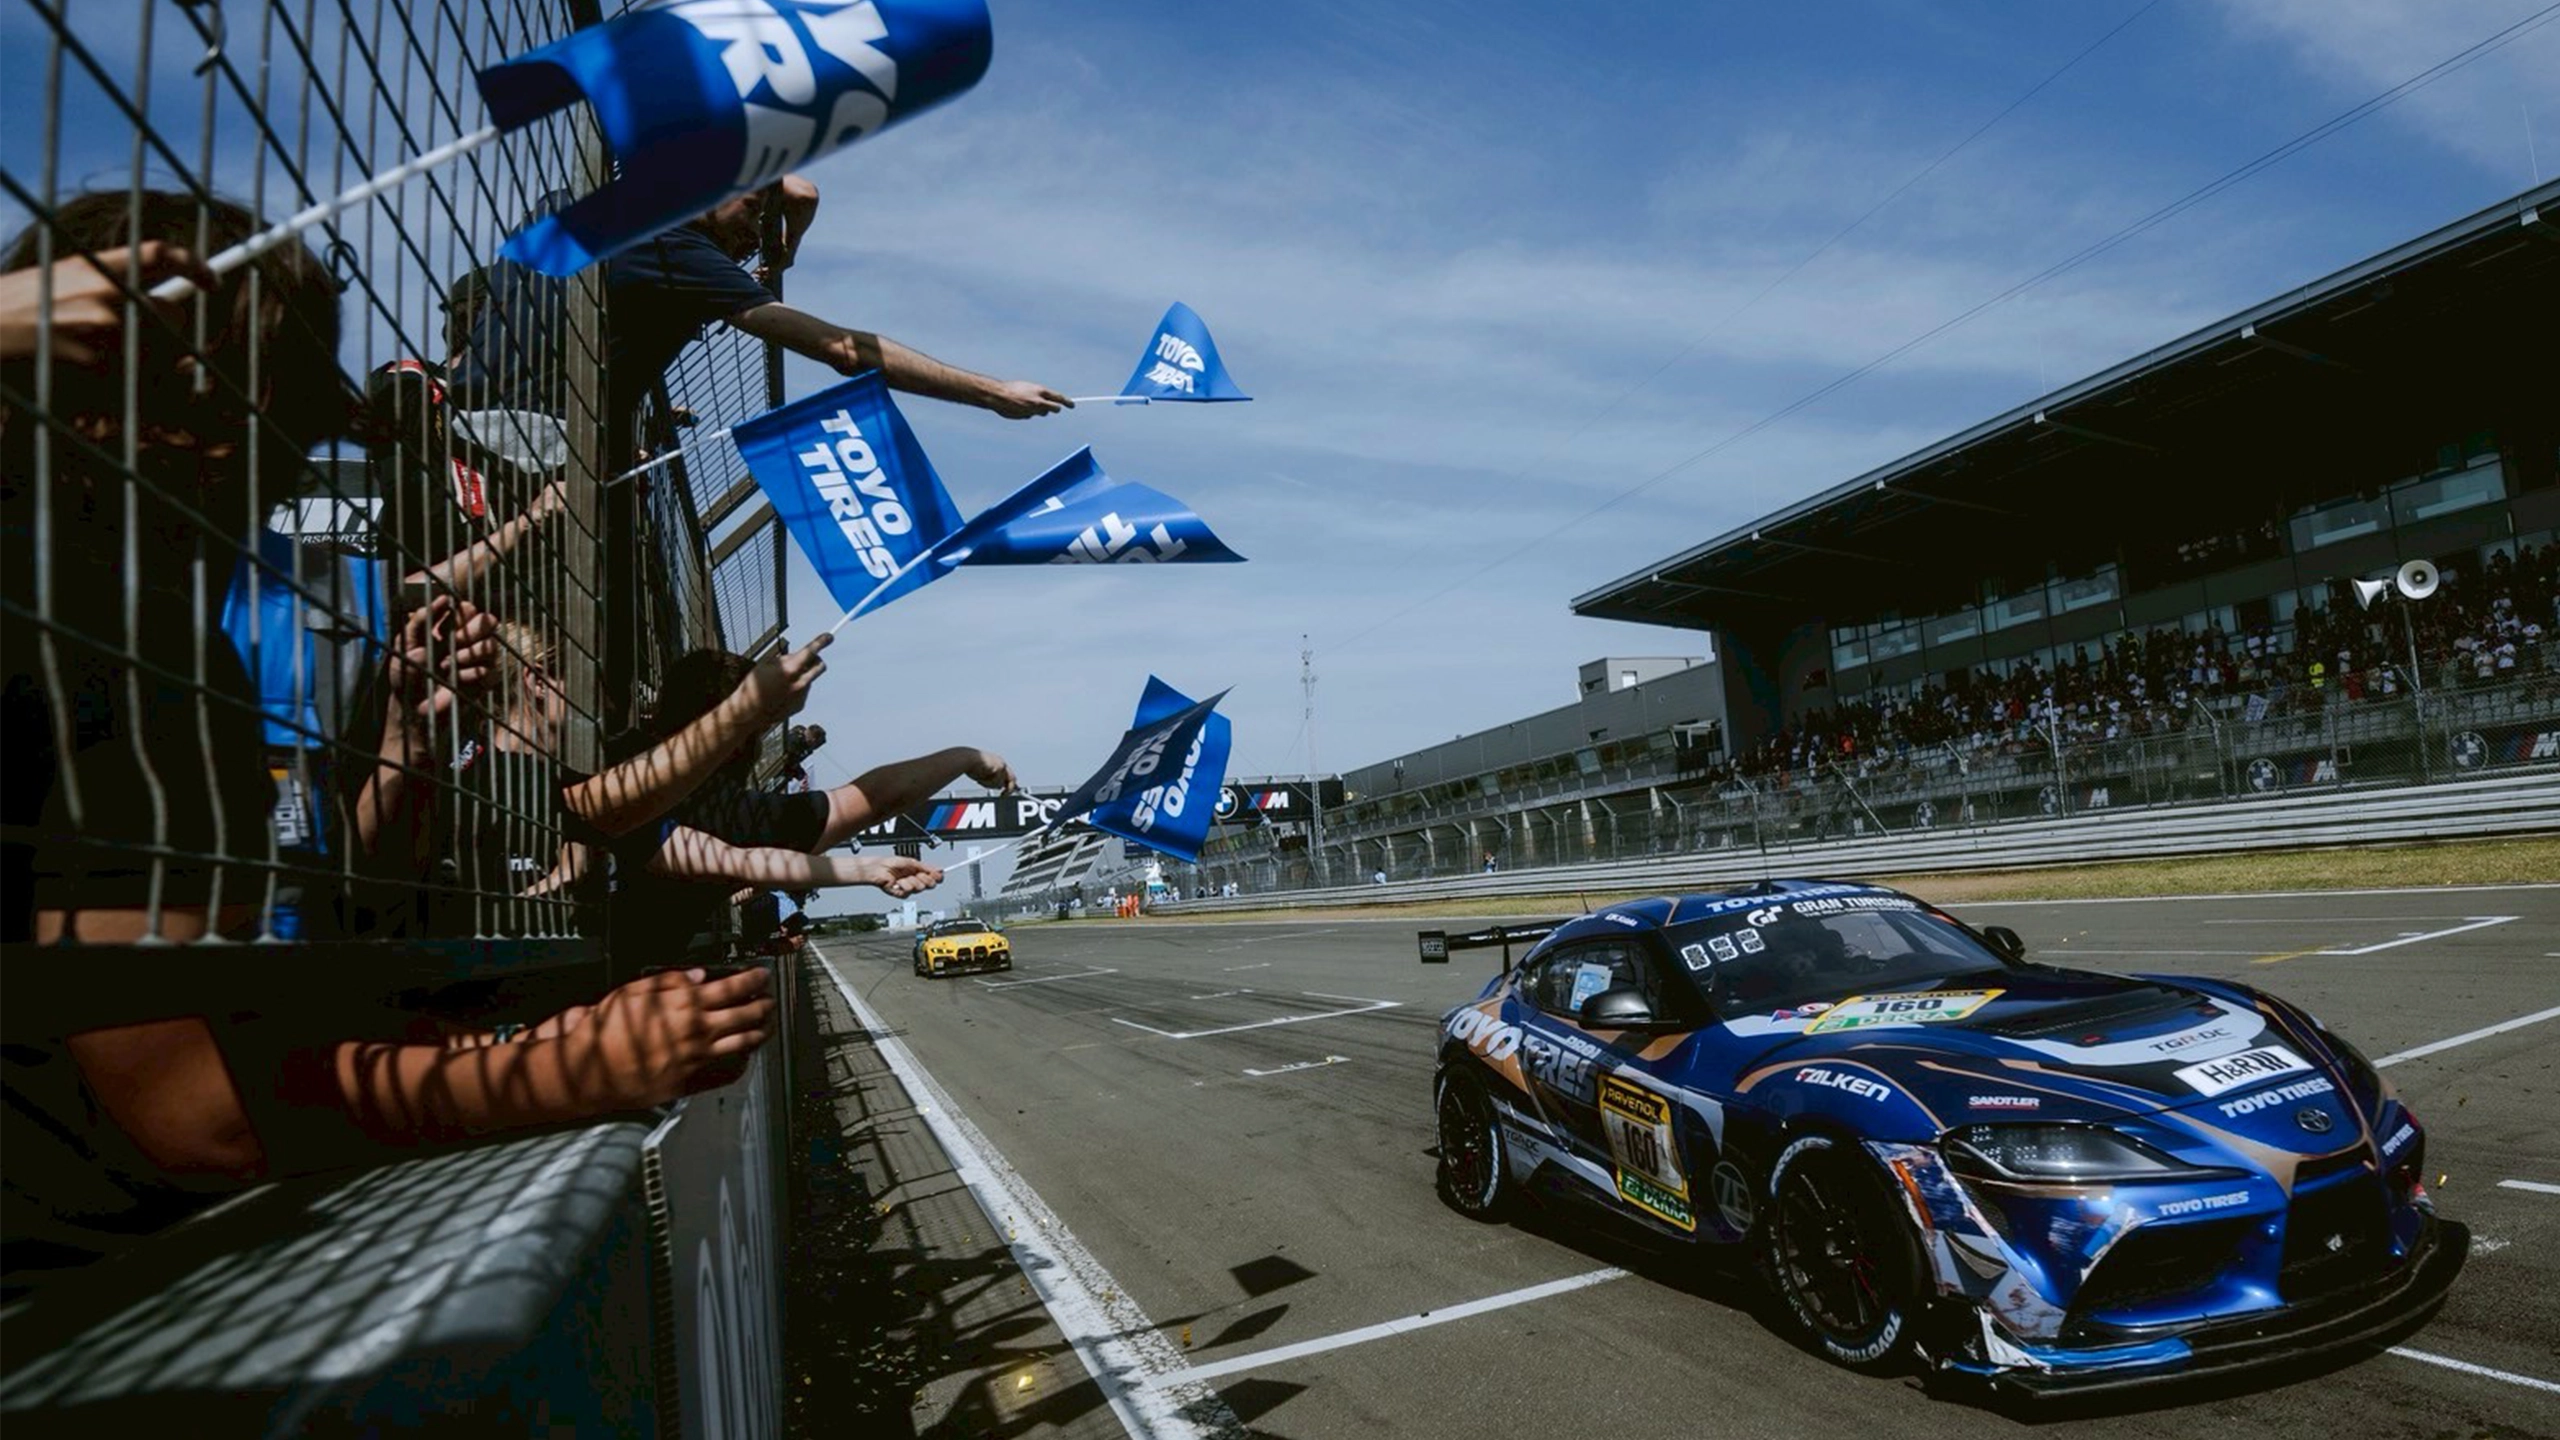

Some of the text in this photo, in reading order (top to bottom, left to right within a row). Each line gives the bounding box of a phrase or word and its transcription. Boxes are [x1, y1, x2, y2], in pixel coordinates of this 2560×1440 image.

[1154, 332, 1206, 373] TOYO
[820, 409, 913, 535] TOYO
[798, 442, 901, 579] TIRES
[1705, 893, 1788, 913] TOYO
[1792, 898, 1843, 914] GRAN
[1857, 1010, 1949, 1025] DEKRA
[1873, 999, 1944, 1014] 160
[2149, 1027, 2231, 1052] TGR-DC
[2198, 1057, 2262, 1084] H&R
[1794, 1067, 1891, 1103] FALKEN
[2217, 1076, 2335, 1118] TOYO TIRES
[1606, 1086, 1662, 1120] RAVENOL
[1967, 1095, 2041, 1108] SANDTLER
[1622, 1120, 1660, 1177] 160
[2158, 1190, 2250, 1216] TOYO TIRES
